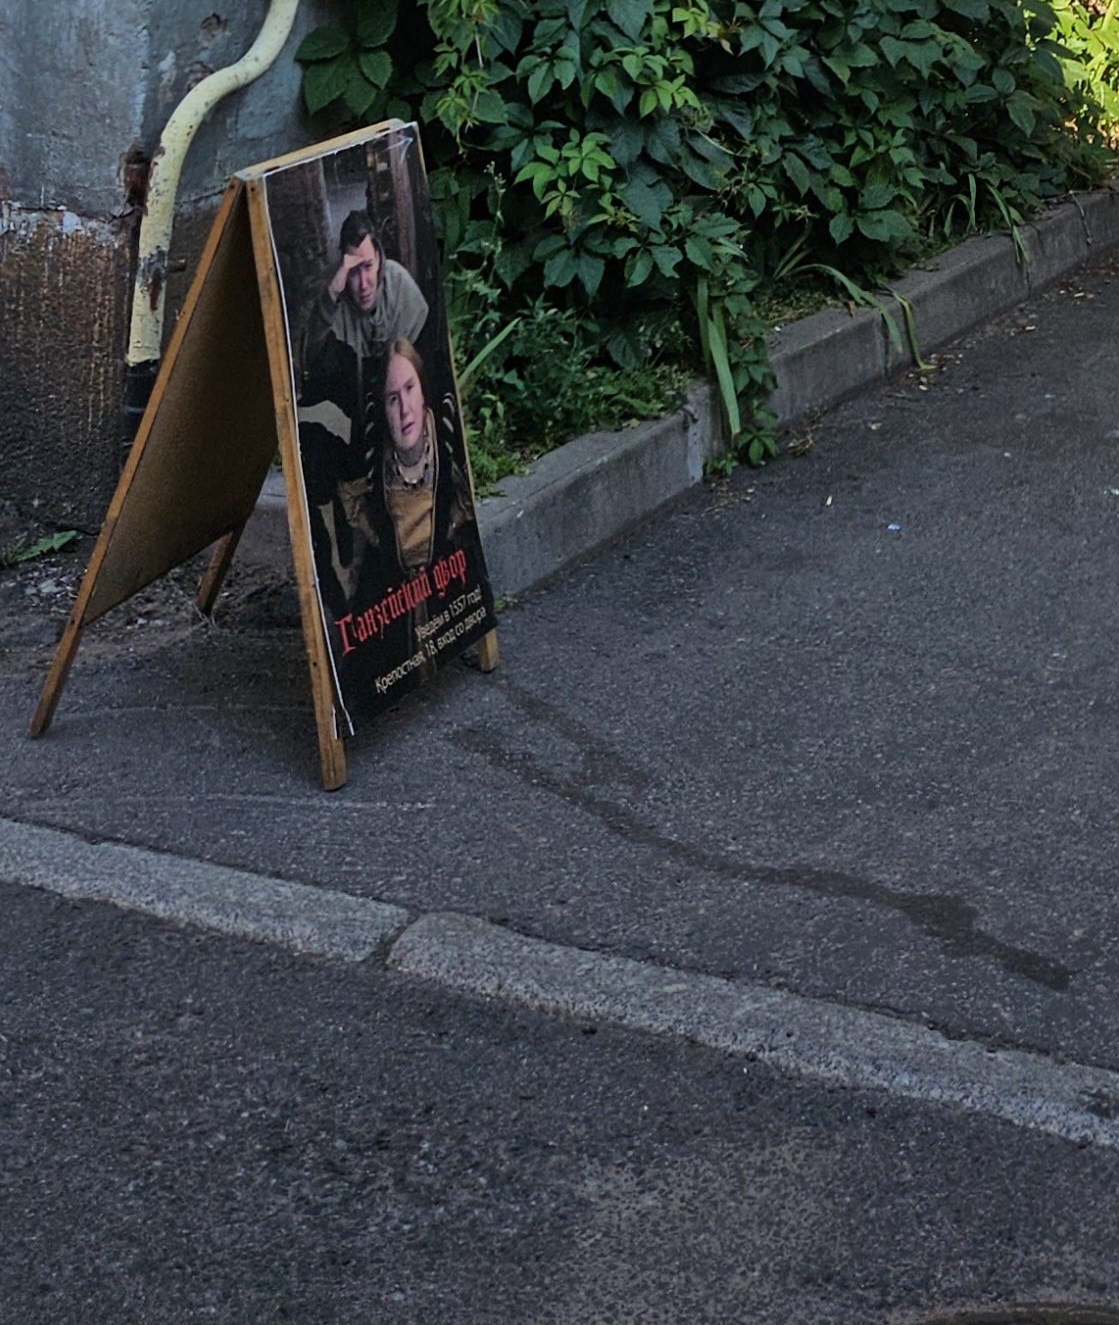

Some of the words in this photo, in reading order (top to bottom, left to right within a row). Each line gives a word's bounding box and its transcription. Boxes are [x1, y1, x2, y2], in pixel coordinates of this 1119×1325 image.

[335, 565, 432, 657] Ганзейский
[433, 549, 467, 598] двор
[415, 615, 444, 642] Уведём
[443, 611, 451, 622] в
[449, 594, 467, 616] 1557
[467, 584, 482, 603] год!
[438, 631, 457, 648] вход
[456, 623, 465, 636] со
[465, 606, 487, 630] двора
